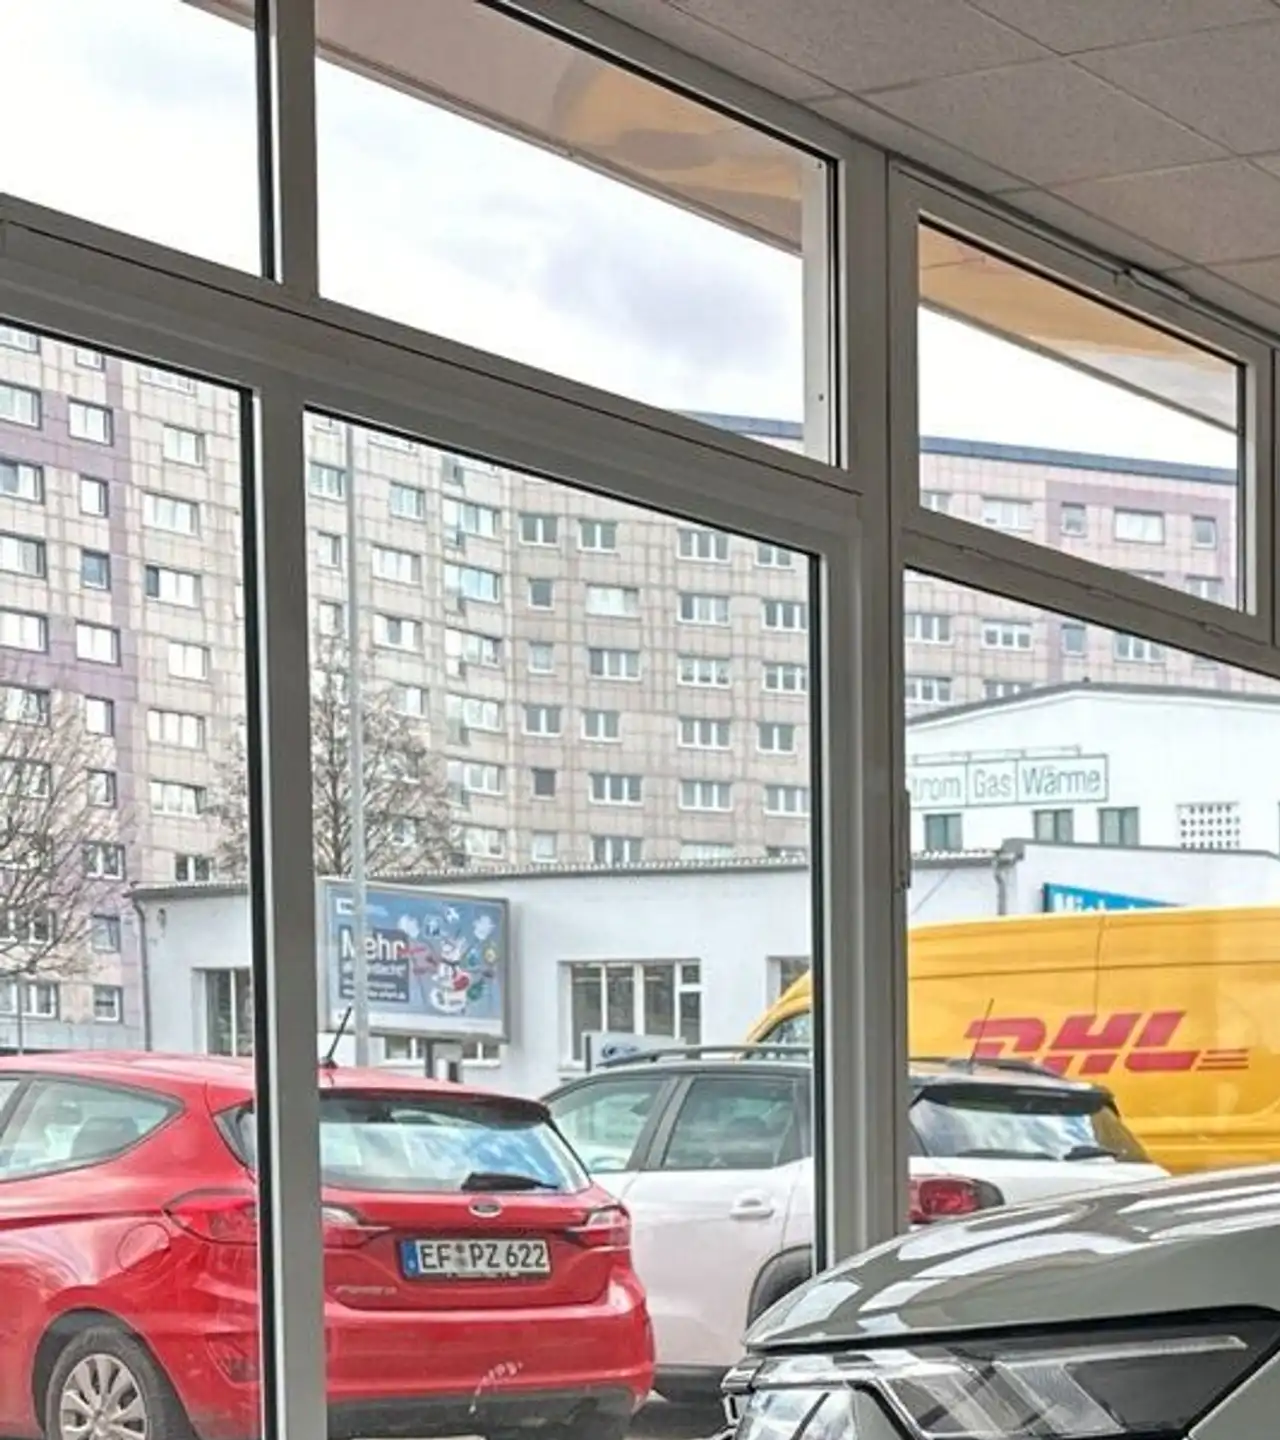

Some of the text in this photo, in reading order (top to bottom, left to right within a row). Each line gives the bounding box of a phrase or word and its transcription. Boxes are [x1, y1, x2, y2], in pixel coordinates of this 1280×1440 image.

[908, 763, 1101, 802] trom Gas Wärme
[964, 1011, 1199, 1076] DHL
[420, 1243, 547, 1269] EF PZ 622
